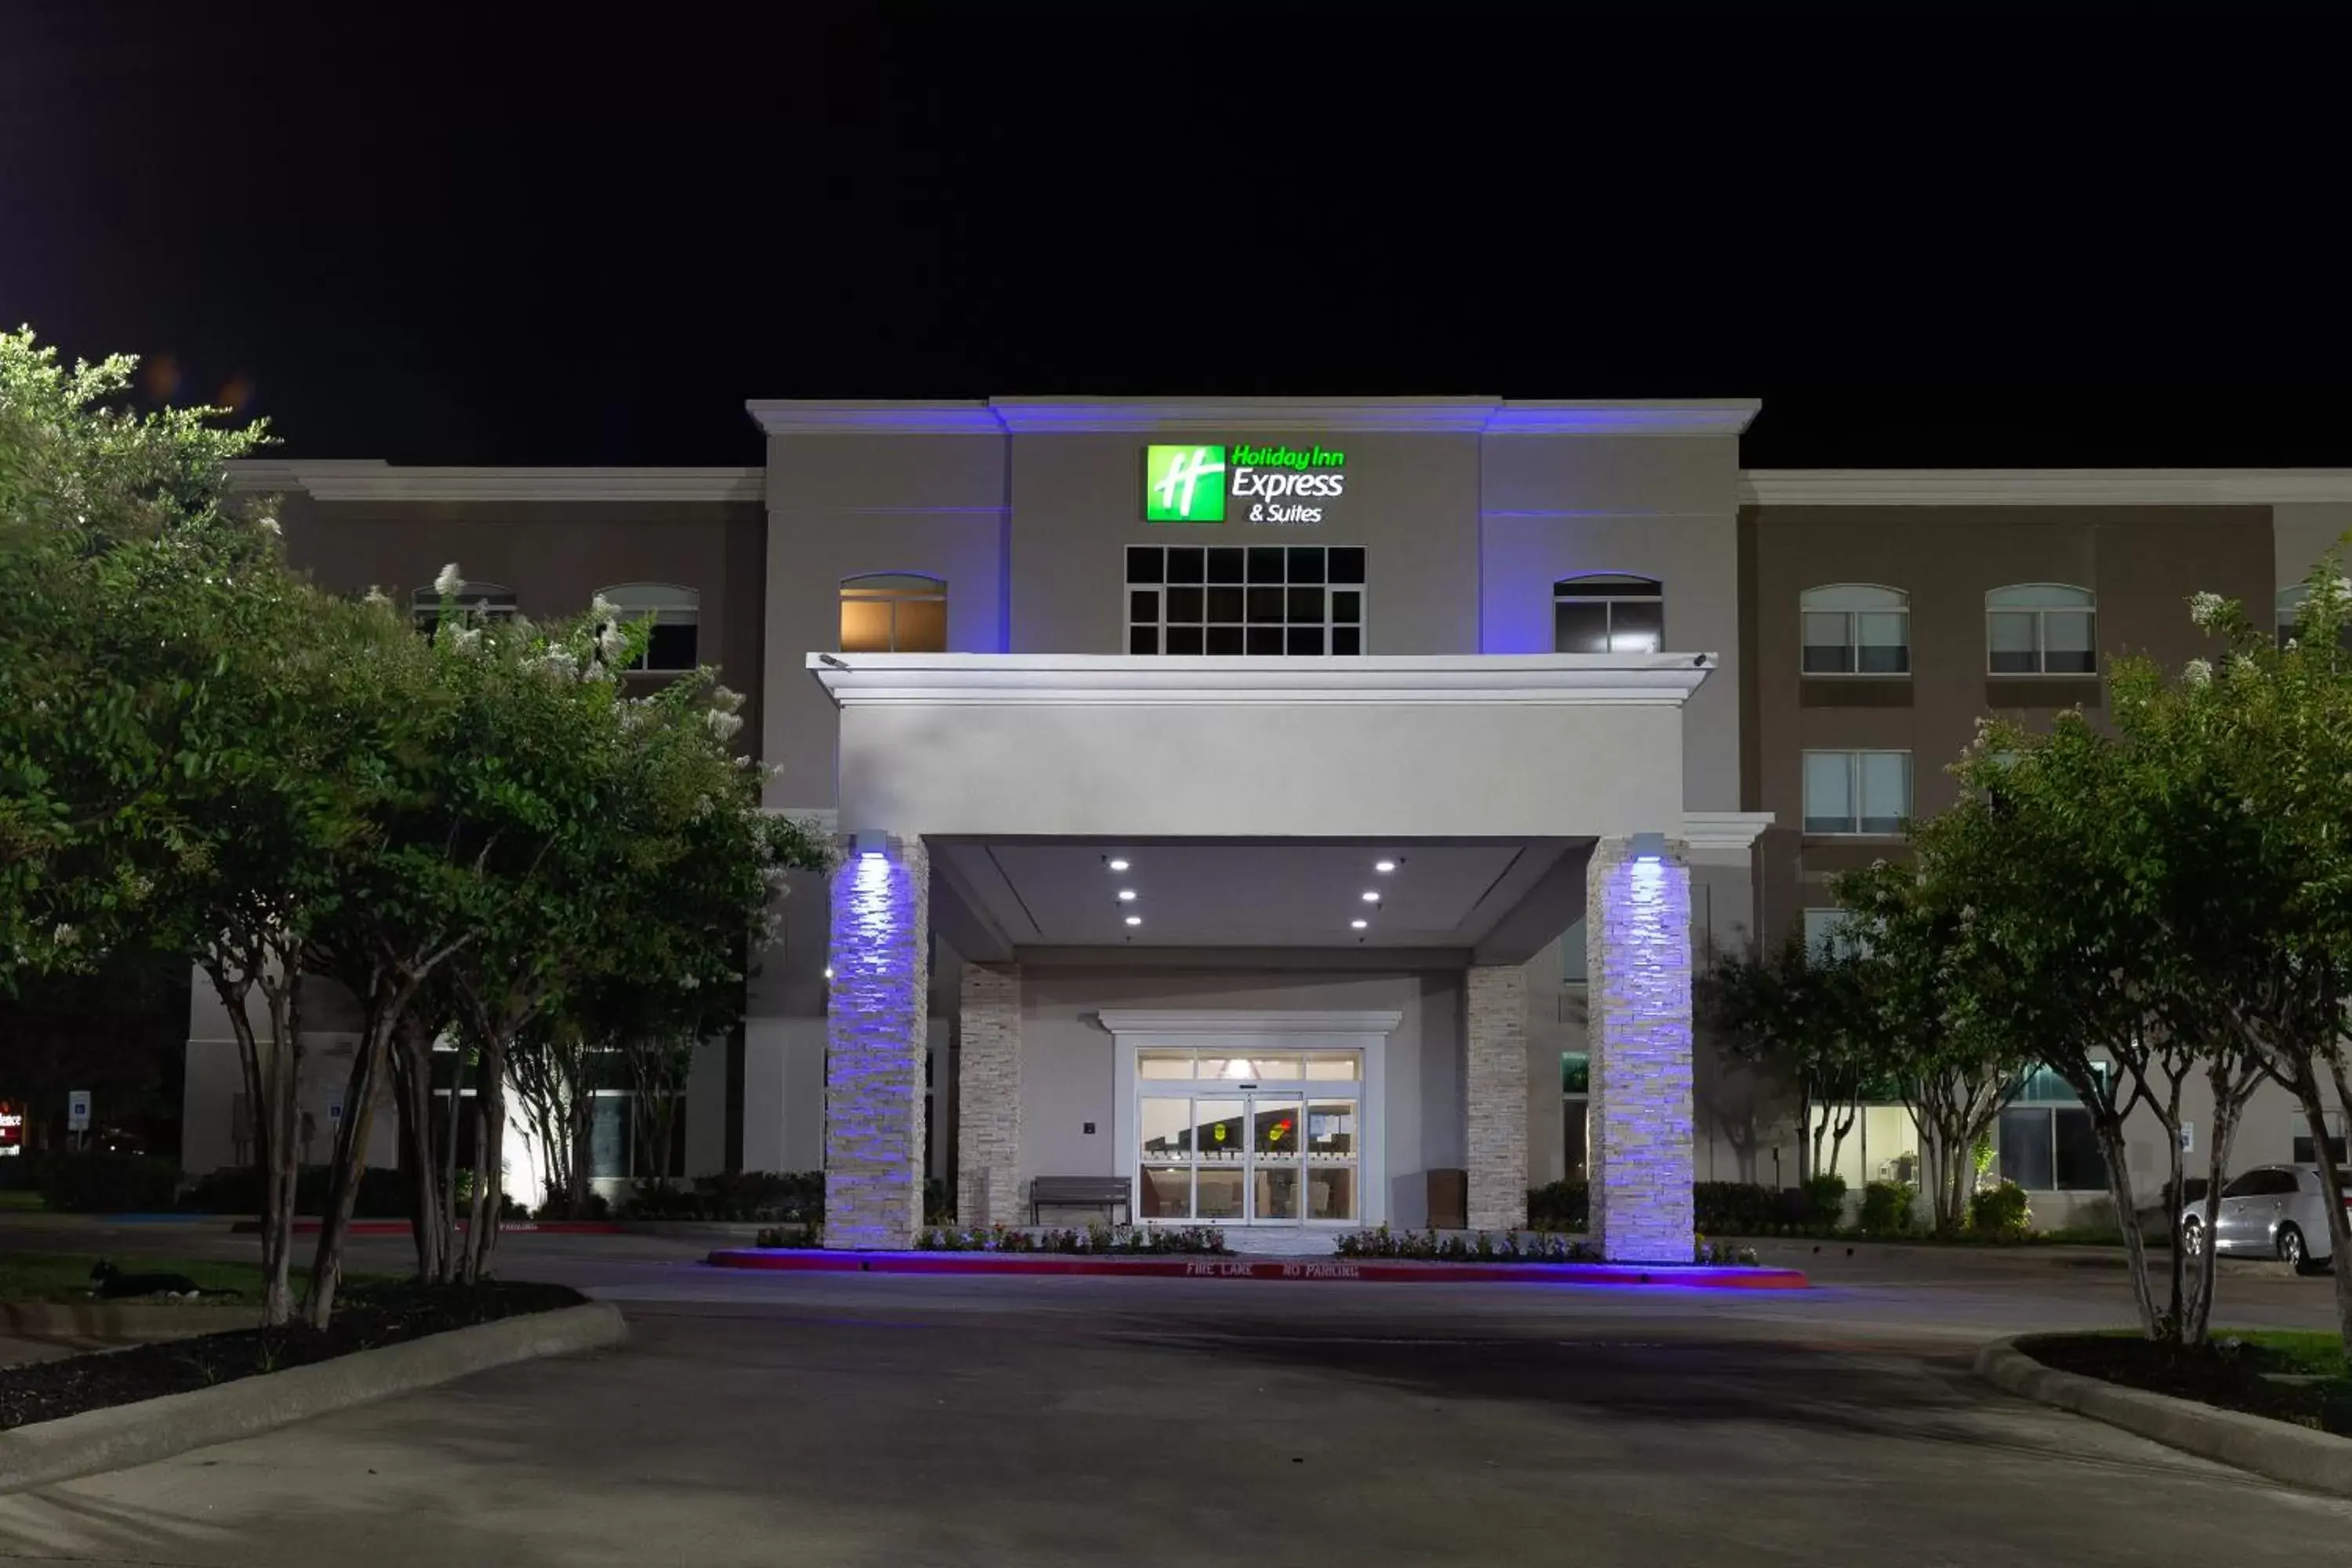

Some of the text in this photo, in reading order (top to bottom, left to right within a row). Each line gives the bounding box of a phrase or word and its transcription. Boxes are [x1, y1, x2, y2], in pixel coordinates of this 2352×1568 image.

[1232, 445, 1345, 470] Holiday Inn
[1232, 468, 1343, 503] Express
[1250, 504, 1322, 522] & Suites
[1186, 1262, 1359, 1277] FIRE LANE NO PARKING
